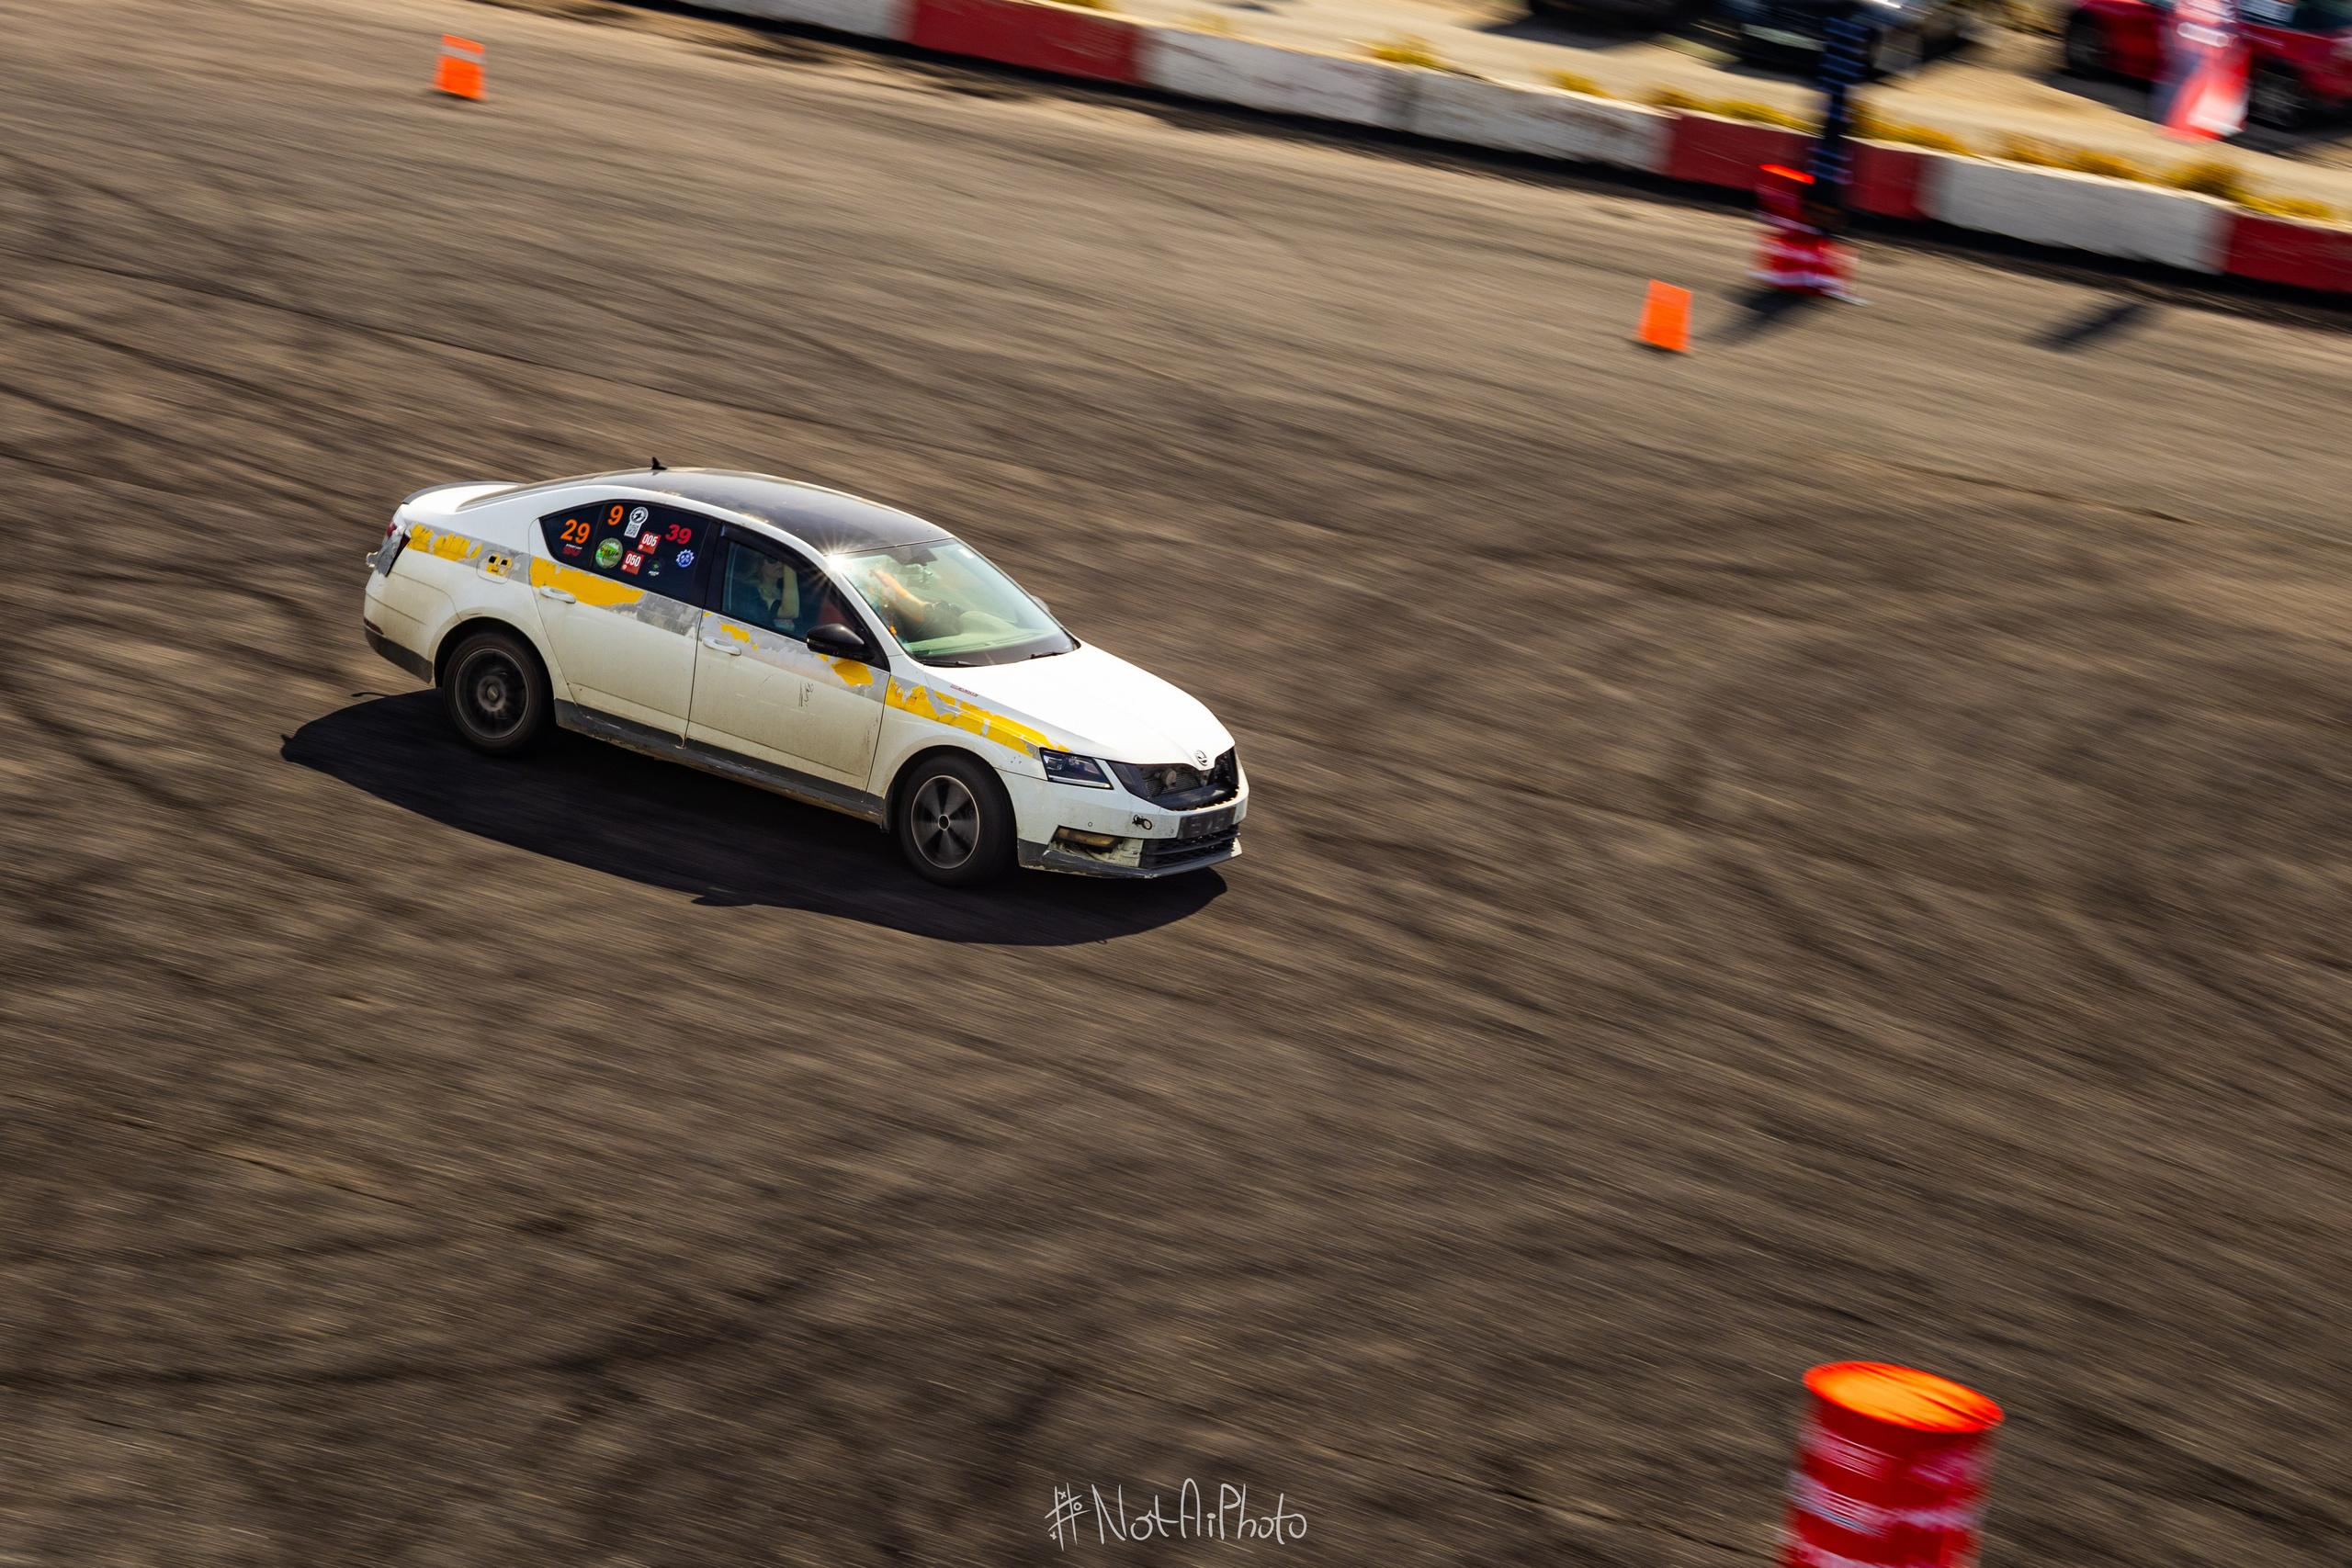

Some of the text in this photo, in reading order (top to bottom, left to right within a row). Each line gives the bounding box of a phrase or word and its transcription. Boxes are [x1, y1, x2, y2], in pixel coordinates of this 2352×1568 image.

[607, 505, 624, 526] 9
[560, 519, 591, 544] 29
[641, 533, 659, 547] 005
[665, 524, 692, 545] 39
[625, 553, 641, 567] 050
